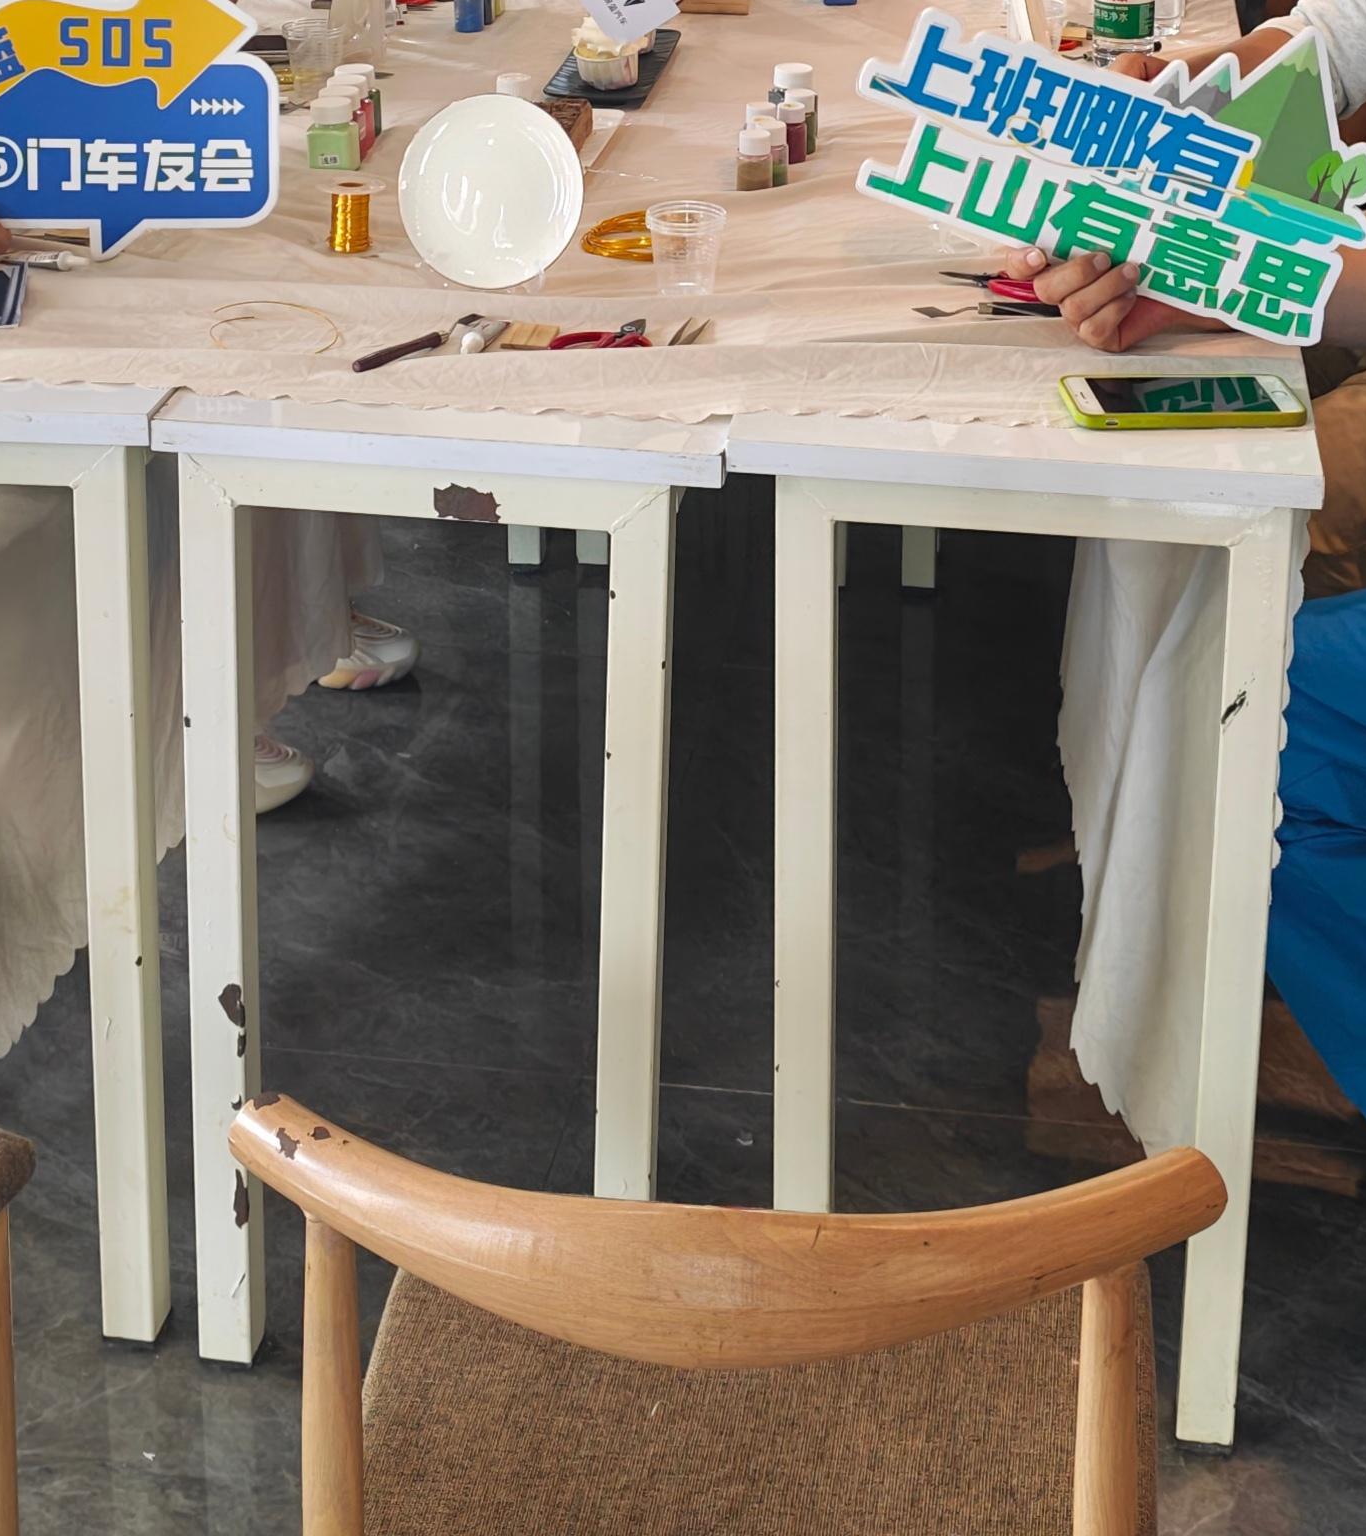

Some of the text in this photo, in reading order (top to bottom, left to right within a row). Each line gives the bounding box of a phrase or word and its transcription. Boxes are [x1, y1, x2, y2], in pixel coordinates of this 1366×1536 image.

[869, 22, 1254, 212] 上班哪有
[865, 122, 1334, 340] 上山有意思
